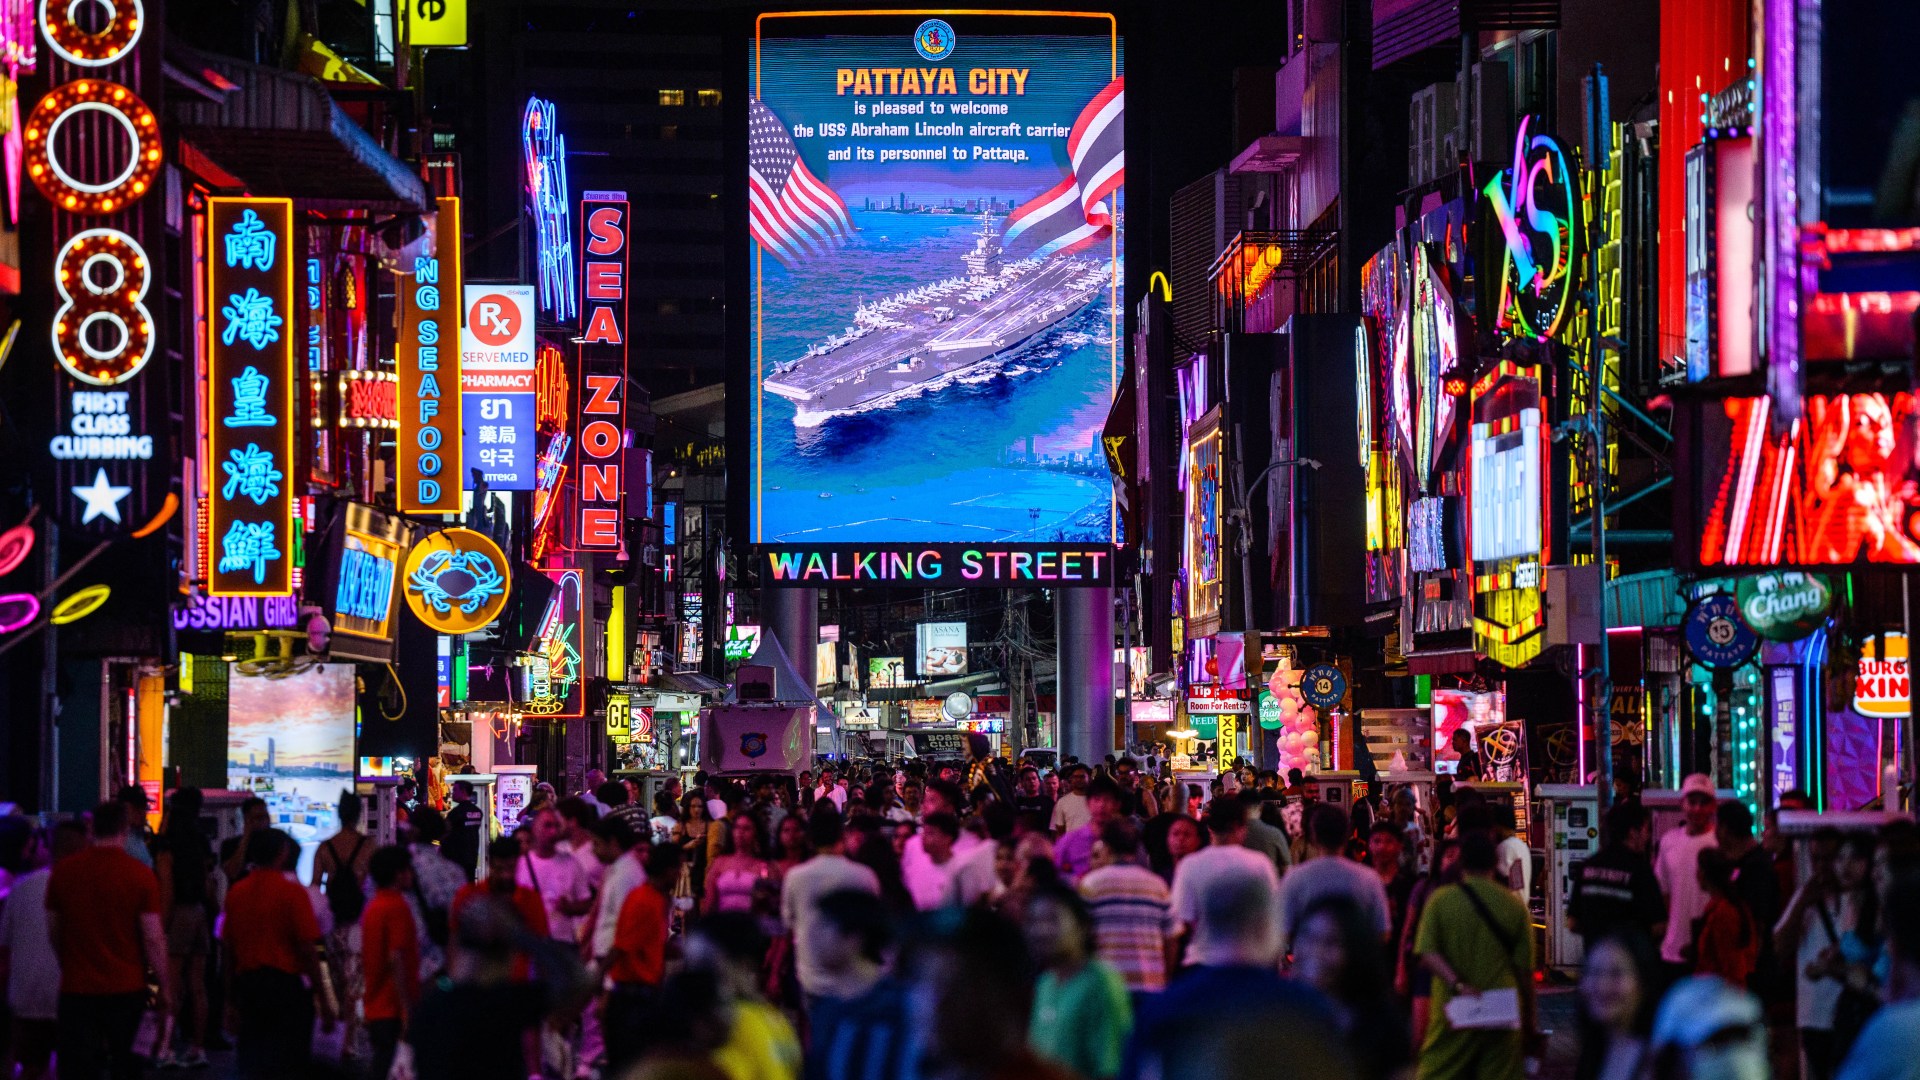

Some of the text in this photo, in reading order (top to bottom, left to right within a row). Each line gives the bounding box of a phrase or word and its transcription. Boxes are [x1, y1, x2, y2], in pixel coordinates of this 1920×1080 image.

[836, 68, 1029, 96] PATTAYA CITY
[854, 100, 1009, 120] is pleased to welcome
[793, 122, 1071, 138] the USS Abraham Lincoln aircraft carrier
[827, 146, 1029, 163] and its personnel to Pattaya.
[462, 351, 530, 364] SERVEMED
[461, 374, 533, 387] PHARMACY
[581, 207, 624, 547] SEA ZONE
[71, 391, 130, 414] FIRST
[219, 208, 284, 586] 南海皇海鮮
[417, 320, 443, 505] SEAFOOD
[480, 397, 513, 420] ยา
[70, 413, 132, 435] CLASS
[478, 425, 517, 445] 藥局
[49, 435, 153, 460] CLUBBING
[479, 448, 515, 468] 약국
[483, 472, 518, 482] птека
[768, 550, 1107, 580] WALKING STREET
[1749, 588, 1822, 619] Chang
[933, 626, 960, 634] ASANA
[1712, 624, 1730, 639] 15
[1700, 642, 1746, 660] PATTAYA
[1193, 686, 1211, 698] Tip
[1318, 681, 1329, 691] 14
[1190, 701, 1240, 710] Room For Rent
[1311, 693, 1338, 704] PATTAYA
